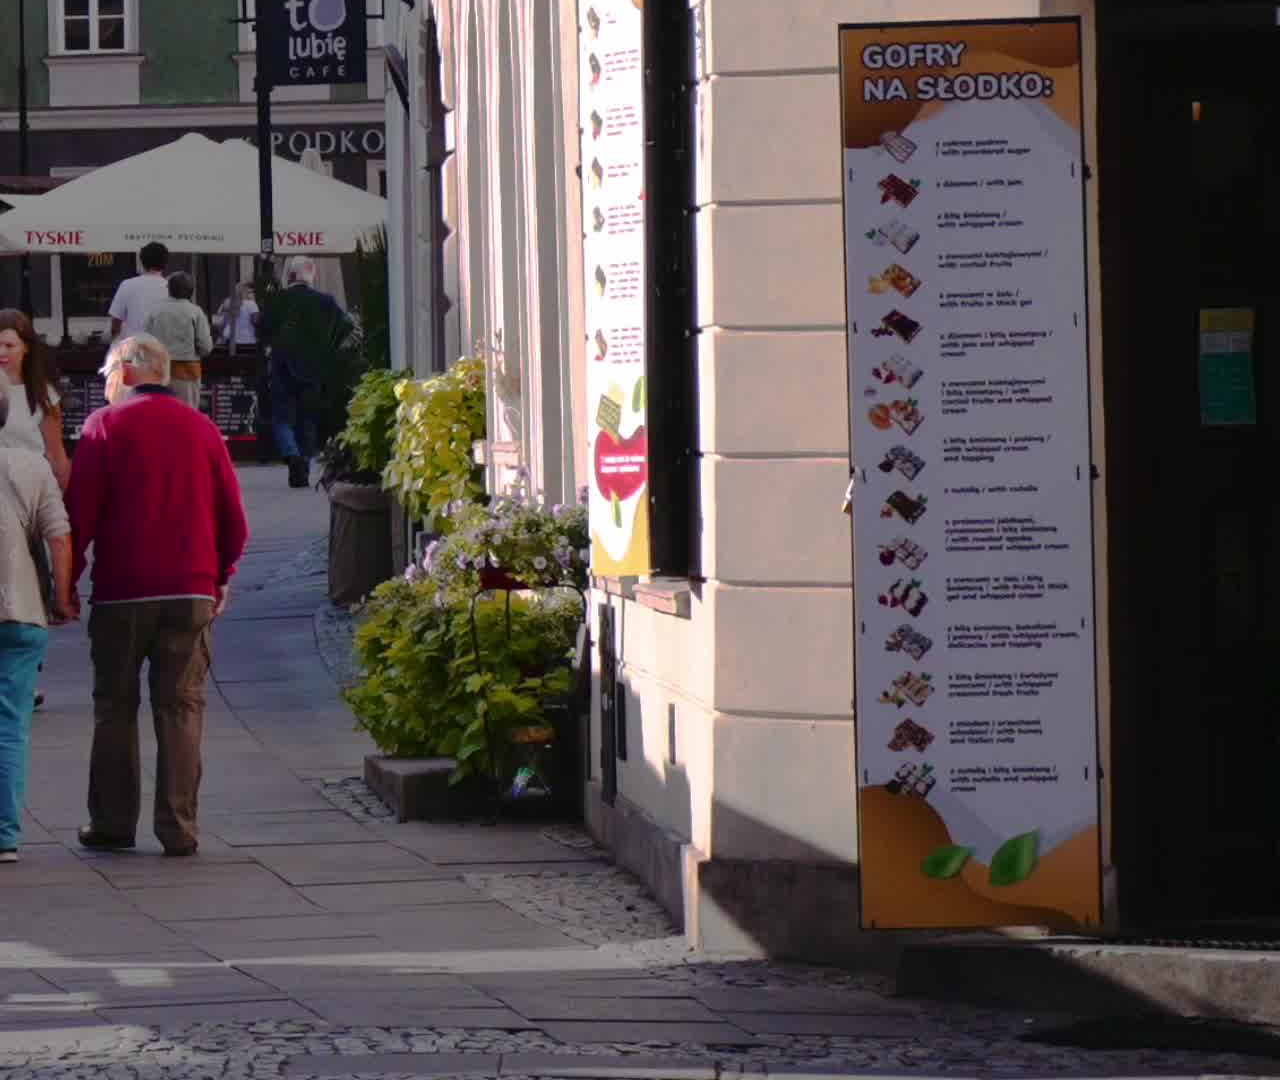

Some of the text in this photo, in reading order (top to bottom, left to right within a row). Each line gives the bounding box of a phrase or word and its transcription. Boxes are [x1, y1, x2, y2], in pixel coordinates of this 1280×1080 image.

[288, 31, 347, 61] lubię
[863, 43, 965, 68] GOFRY
[288, 64, 346, 78] CAFE
[864, 74, 1052, 101] NA SŁODKO:
[24, 231, 85, 246] TYSKIE
[274, 231, 326, 247] YSKIE
